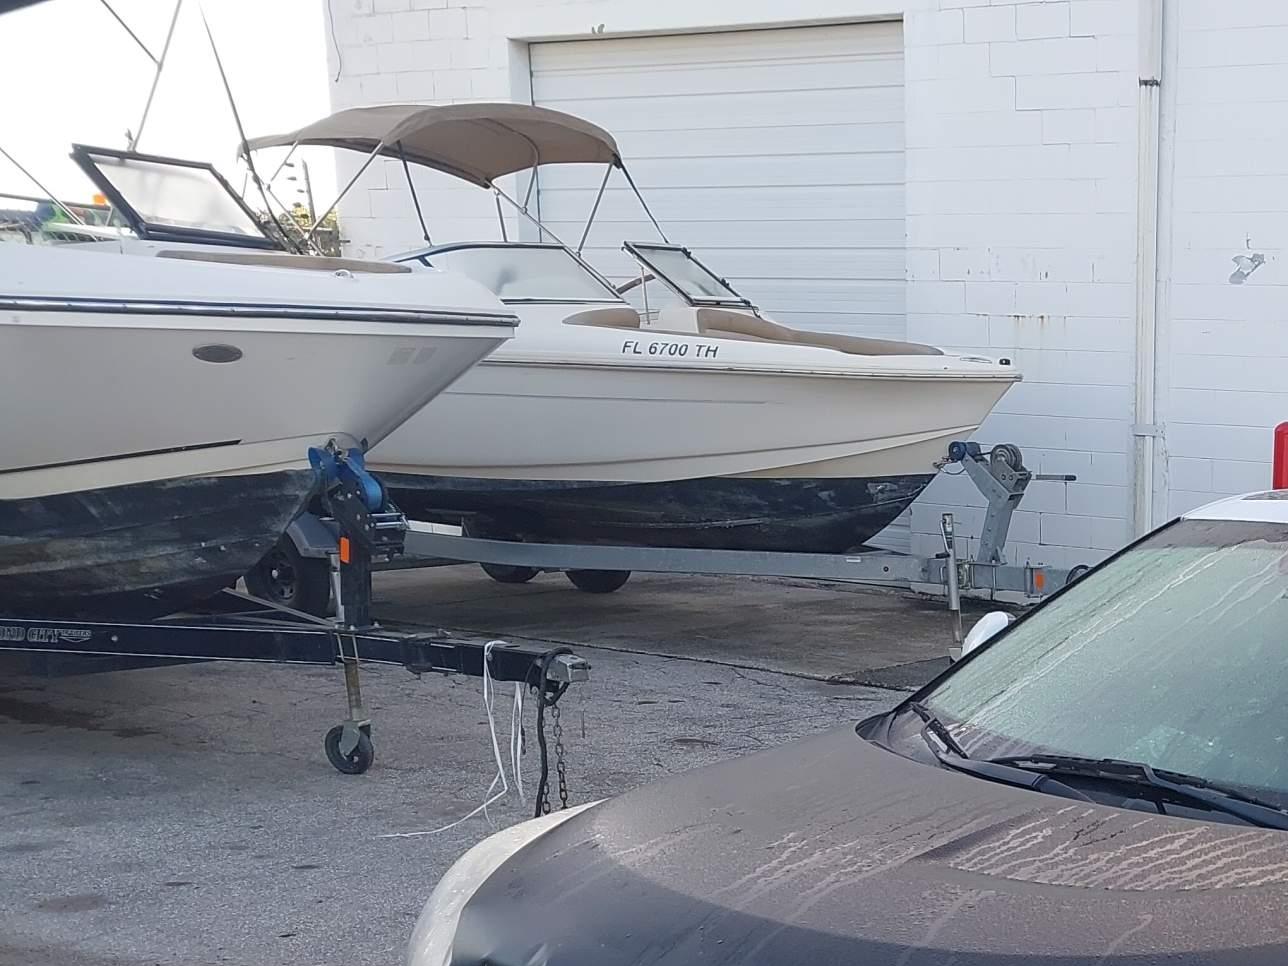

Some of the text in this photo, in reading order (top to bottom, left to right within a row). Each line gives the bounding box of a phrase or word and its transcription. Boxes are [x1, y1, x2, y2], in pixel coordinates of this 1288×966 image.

[622, 341, 719, 358] FL 6700 TH
